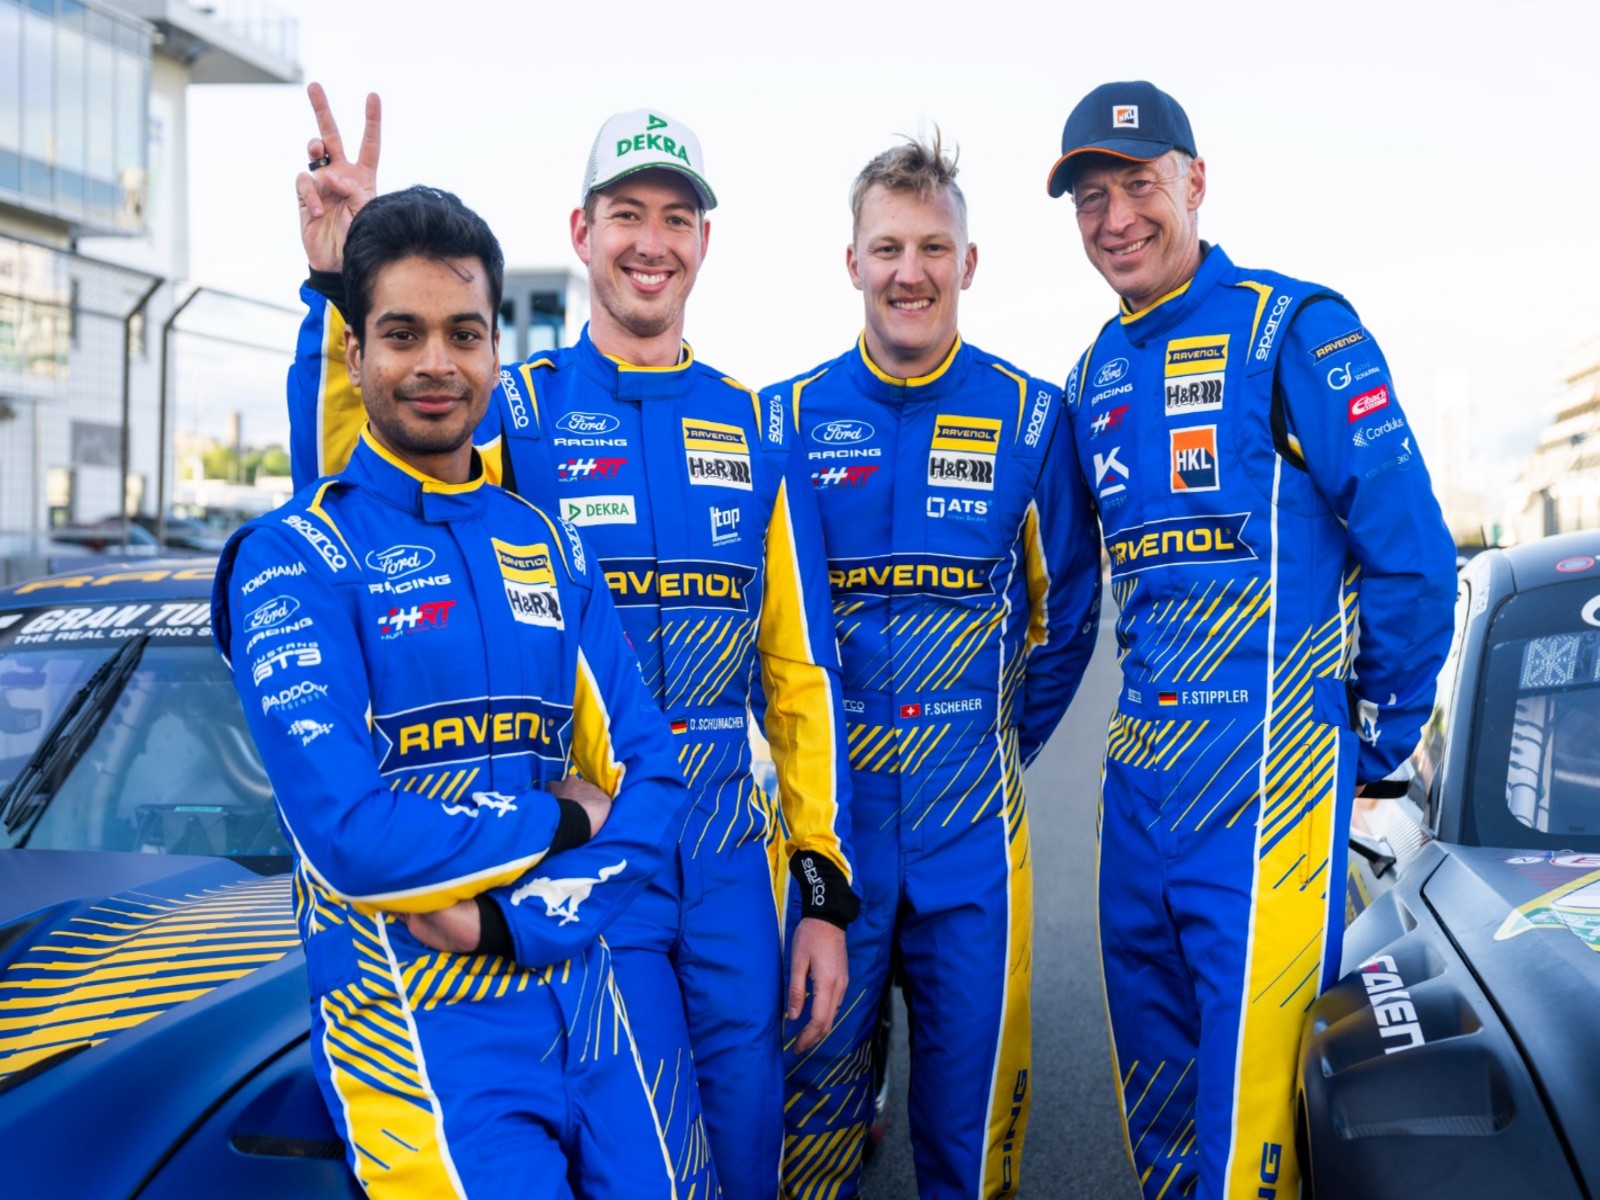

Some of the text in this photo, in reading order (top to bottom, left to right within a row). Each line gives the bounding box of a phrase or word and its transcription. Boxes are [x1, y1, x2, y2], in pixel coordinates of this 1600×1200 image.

[616, 133, 691, 167] DEKRA
[1256, 295, 1293, 361] sparco
[1172, 349, 1220, 361] RAVENOL
[1315, 333, 1363, 358] RAVENOL
[1099, 362, 1123, 384] Ford
[568, 414, 607, 430] Ford
[1024, 390, 1052, 448] sparco
[553, 438, 628, 447] RACING
[690, 429, 740, 442] RAVENOL
[823, 424, 862, 441] Ford
[941, 427, 992, 439] RAVENOL
[808, 448, 882, 460] RACING
[1175, 447, 1212, 471] HKL
[586, 502, 630, 517] DEKRA
[947, 498, 988, 515] ATS
[713, 507, 740, 529] top
[377, 548, 421, 575] Ford
[241, 561, 307, 596] YOKOHAMA
[606, 571, 741, 599] AVENOL
[20, 604, 151, 634] GRAN
[251, 600, 288, 628] Ford
[14, 633, 52, 645] THE
[54, 629, 105, 641] REAL
[109, 626, 194, 638] DRVING
[253, 647, 322, 687] GT3
[924, 698, 982, 716] F.SCHERER
[1182, 689, 1249, 705] F.STIPPLER
[400, 712, 550, 756] RAVENL
[1001, 1069, 1028, 1191] CING
